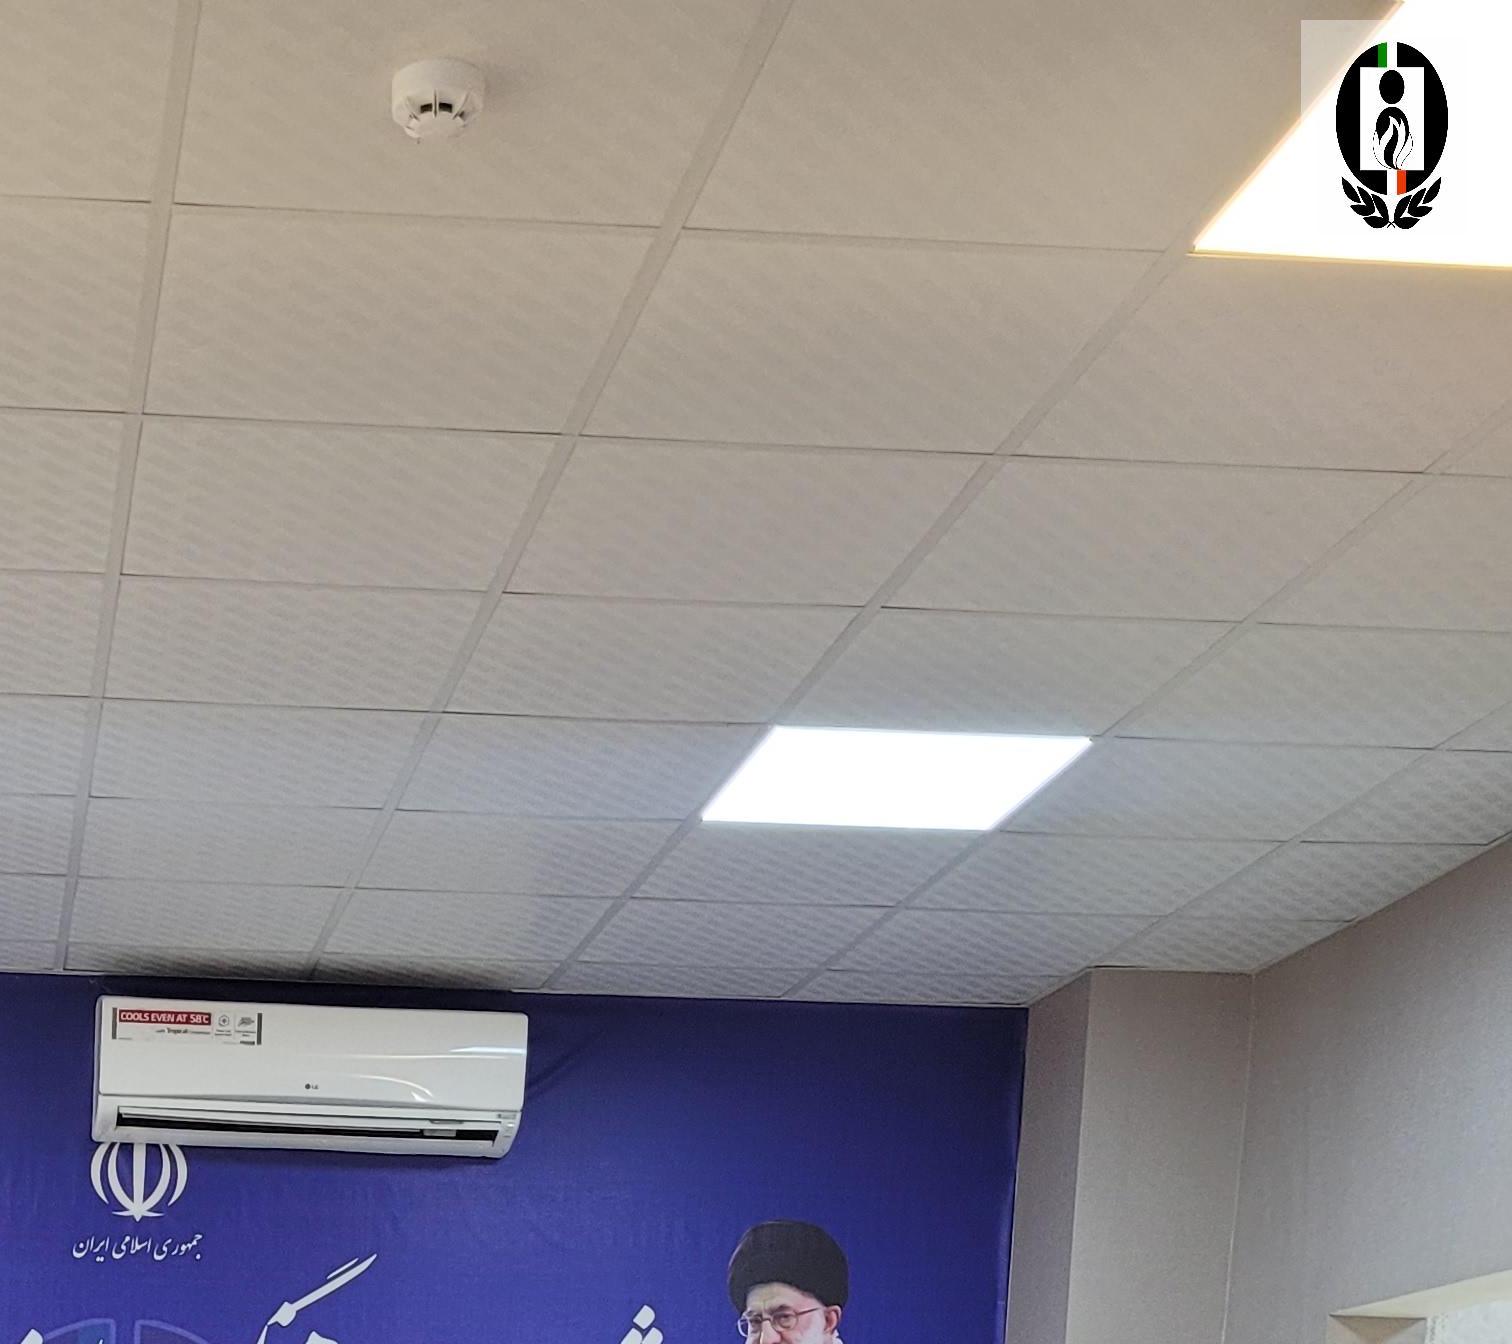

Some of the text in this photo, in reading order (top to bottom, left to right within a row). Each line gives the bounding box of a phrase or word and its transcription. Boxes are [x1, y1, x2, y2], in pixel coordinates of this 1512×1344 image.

[120, 1012, 149, 1022] COOLS
[151, 1013, 174, 1022] EVEN
[175, 1014, 188, 1023] AT
[72, 1233, 203, 1262] جمهوری اسلامی ایران
